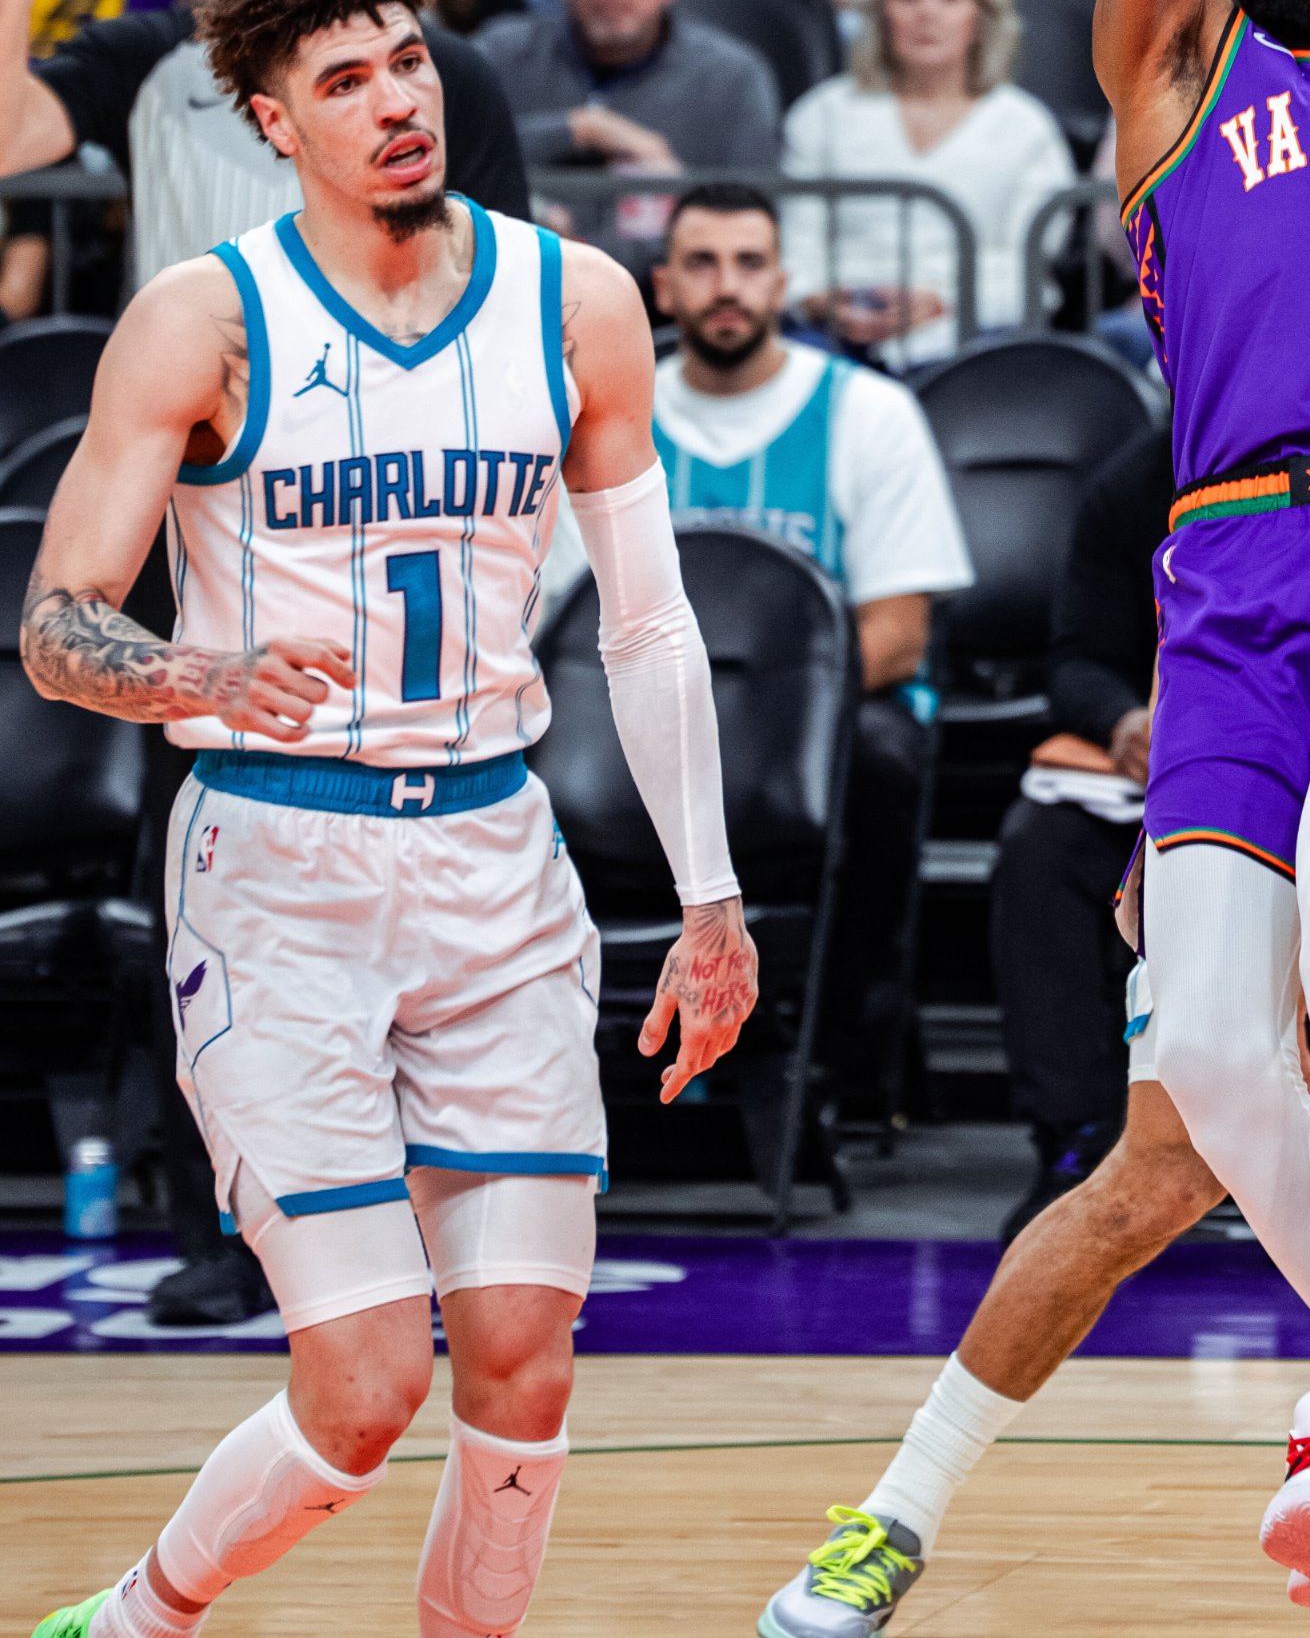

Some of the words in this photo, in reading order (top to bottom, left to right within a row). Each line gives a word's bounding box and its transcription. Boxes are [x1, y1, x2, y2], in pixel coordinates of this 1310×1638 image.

[261, 448, 555, 530] CHARLOTTE
[385, 549, 441, 704] 1
[689, 955, 724, 982] NOT
